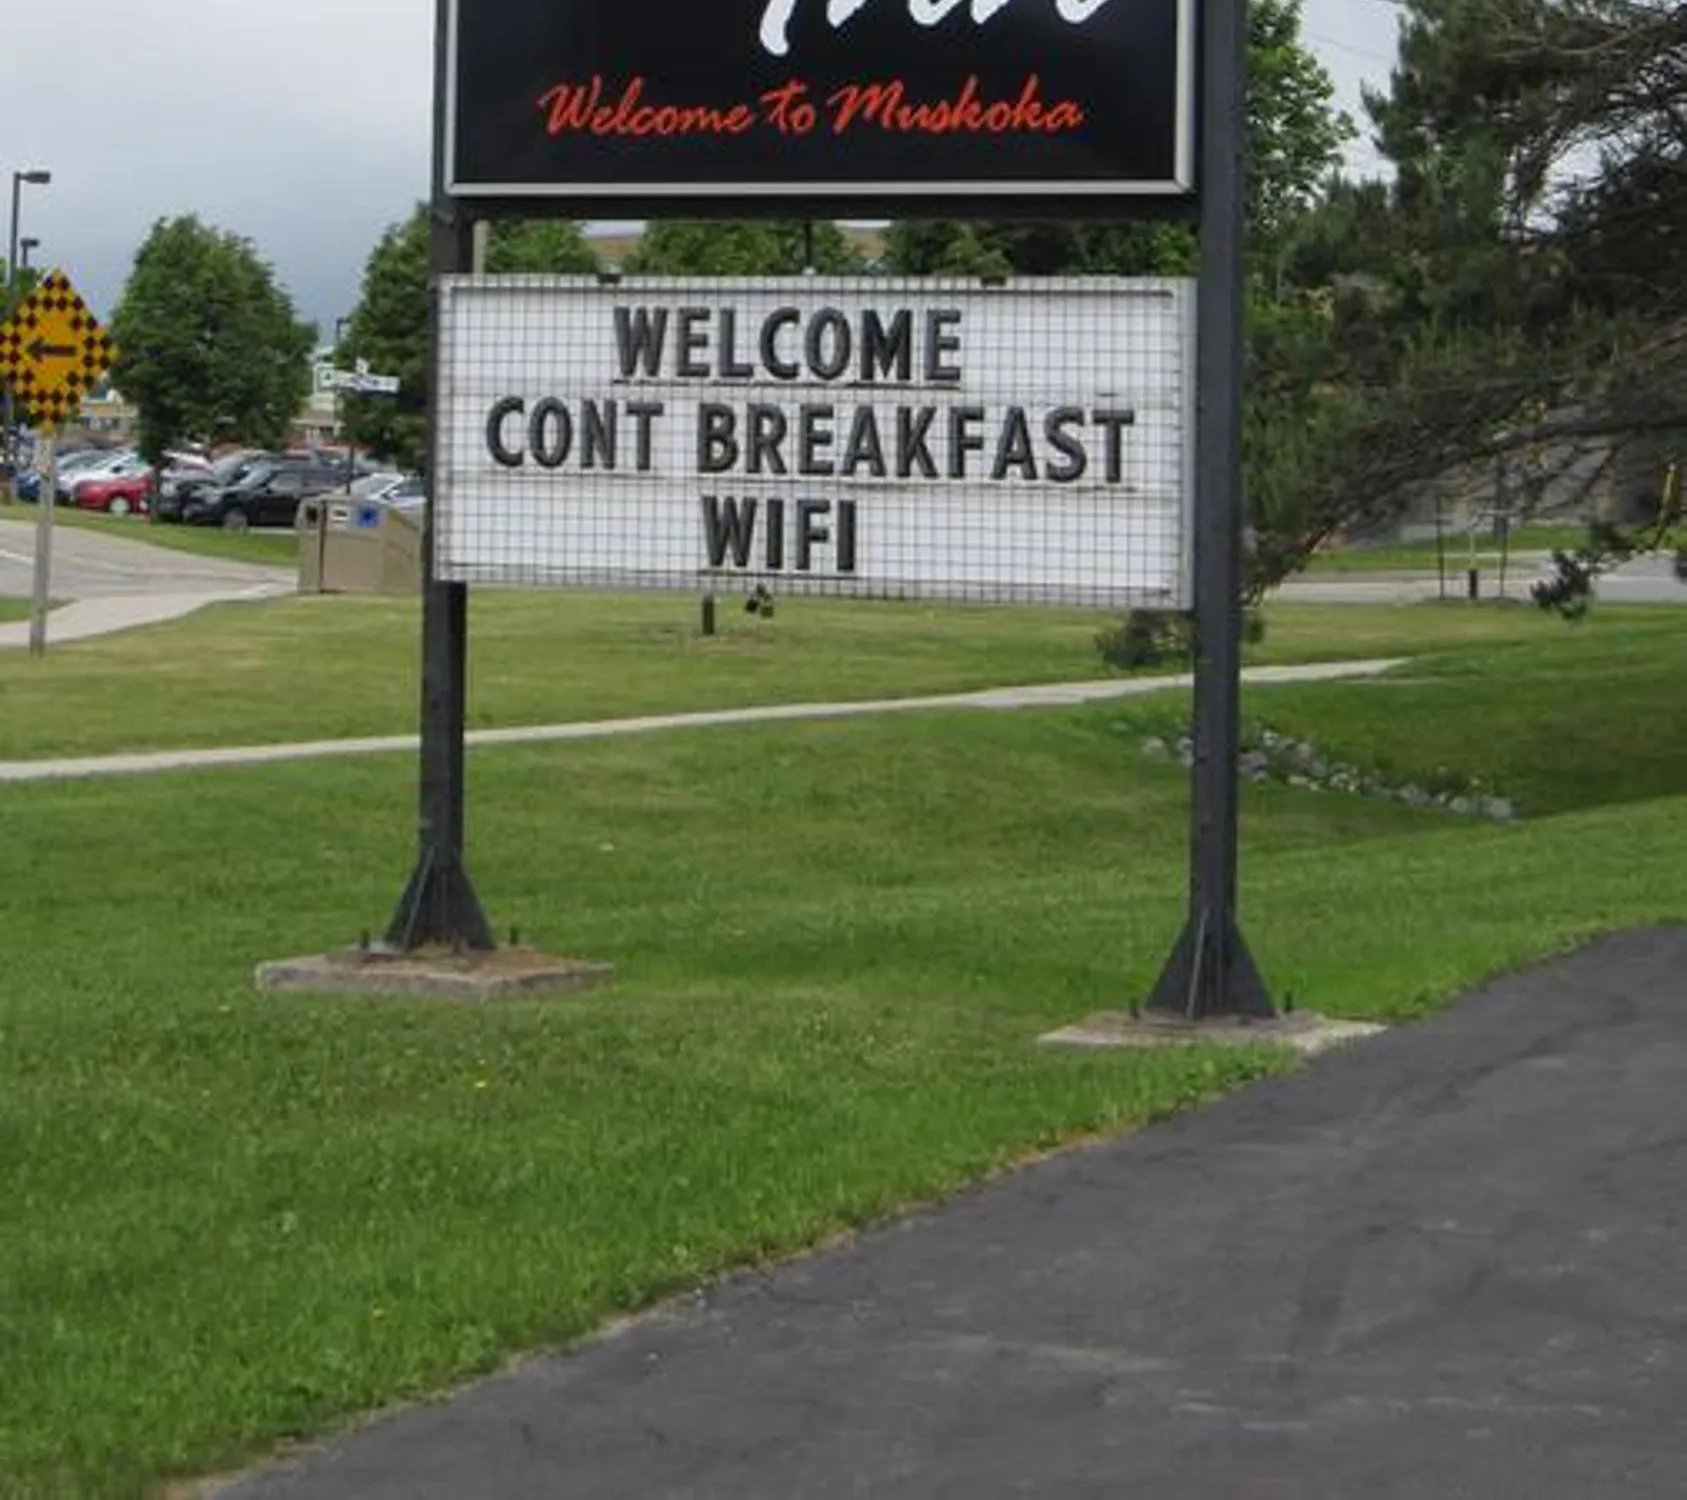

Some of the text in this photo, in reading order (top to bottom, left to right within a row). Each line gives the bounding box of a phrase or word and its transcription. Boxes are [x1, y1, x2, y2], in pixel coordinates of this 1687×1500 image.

[537, 75, 1084, 135] Welcome to Muskoka
[613, 306, 962, 382] WELCOME
[486, 396, 1135, 484] CONT BREAKFAST
[701, 496, 859, 572] WIFI
